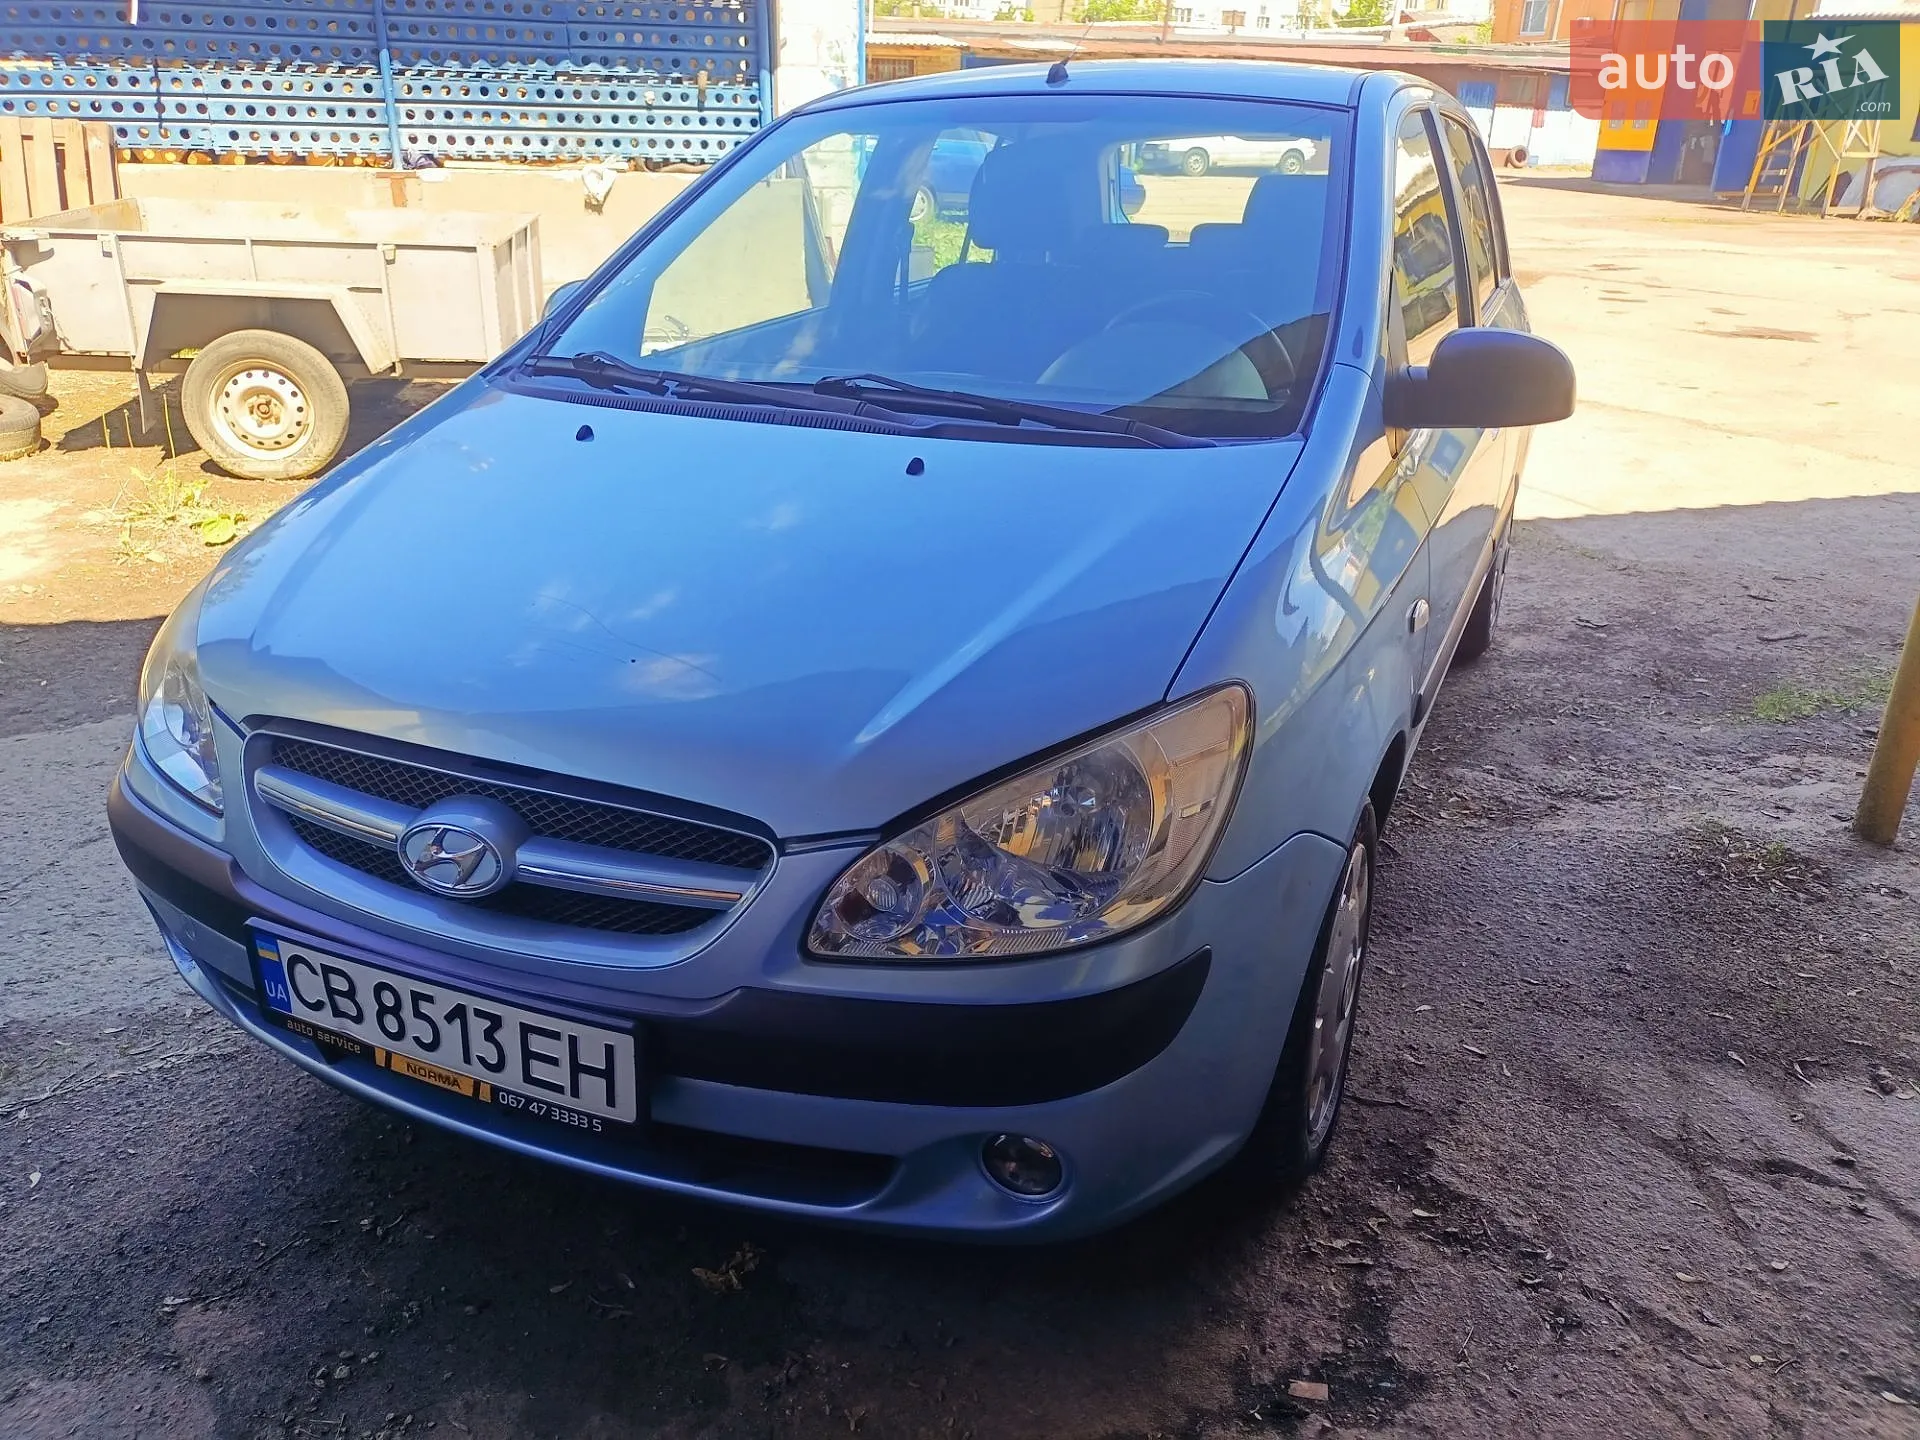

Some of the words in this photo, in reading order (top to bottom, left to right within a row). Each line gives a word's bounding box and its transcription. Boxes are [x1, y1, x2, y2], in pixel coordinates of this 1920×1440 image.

[264, 979, 288, 1003] UA
[286, 953, 364, 1025] CB
[373, 980, 506, 1074] 8513
[519, 1021, 616, 1109] EH
[287, 1019, 314, 1037] auto
[317, 1028, 362, 1055] service
[406, 1062, 462, 1090] NORMA
[499, 1091, 525, 1109] 067
[528, 1101, 547, 1116] 47
[551, 1108, 589, 1129] 3333
